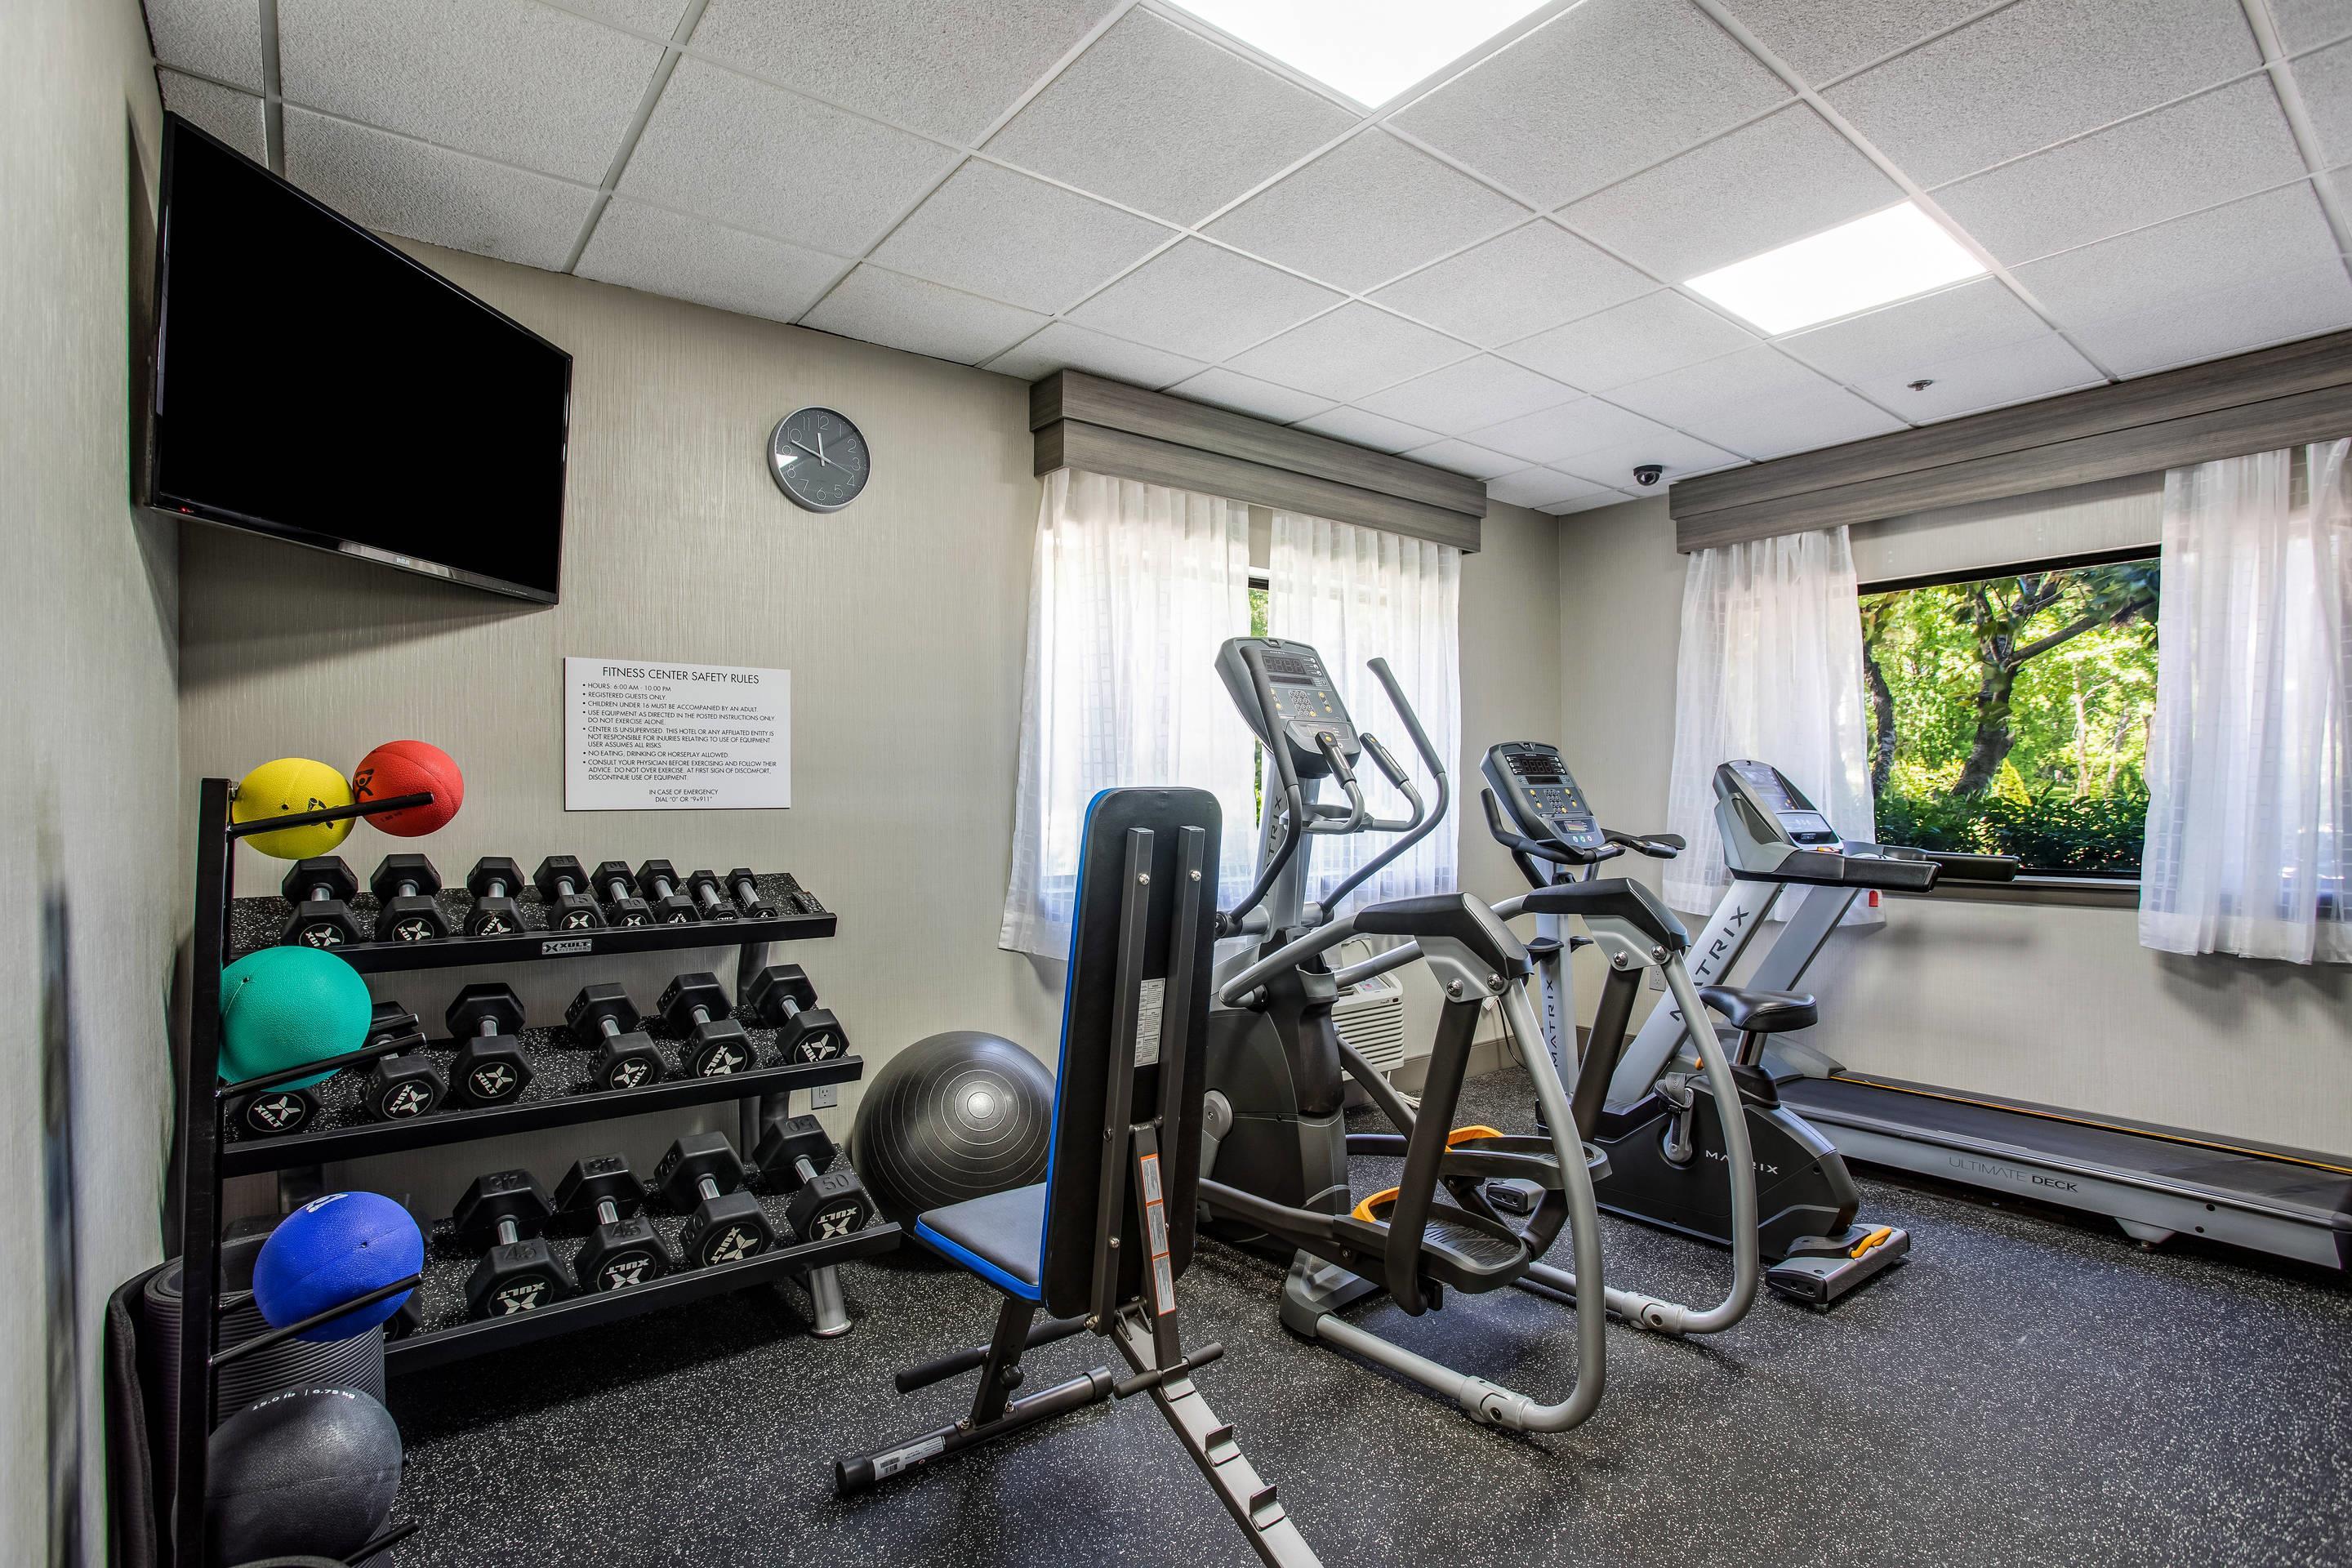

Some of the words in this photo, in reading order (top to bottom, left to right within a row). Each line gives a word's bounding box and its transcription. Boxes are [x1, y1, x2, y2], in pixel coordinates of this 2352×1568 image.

[802, 416, 810, 431] 11
[817, 414, 829, 430] 12
[787, 427, 802, 443] 10
[848, 439, 856, 453] 2
[787, 464, 796, 478] 8
[851, 457, 860, 471] 3
[800, 479, 809, 493] 7
[846, 474, 856, 487] 4
[817, 487, 826, 500] 6
[834, 485, 843, 498] 5
[603, 667, 645, 678] FITNESS
[648, 669, 688, 680] CENTER
[692, 672, 727, 682] SAFETY
[731, 674, 759, 684] RULES
[1266, 796, 1282, 869] TRIX
[1670, 906, 1749, 1021] TRIX
[1547, 980, 1558, 1067] MATRIX
[801, 1042, 819, 1062] XUL
[704, 1045, 728, 1077] XULT
[475, 1072, 497, 1094] XULT
[627, 1064, 647, 1088] XULT
[390, 1084, 413, 1113] XULT
[255, 1104, 283, 1127] XULT
[1706, 1150, 1777, 1174] MAIX
[823, 1174, 849, 1190] 50
[1949, 1156, 2026, 1182] ULTIMATE
[2032, 1175, 2078, 1192] DECK
[817, 1207, 858, 1224] XULT
[710, 1226, 741, 1264] XULT
[606, 1258, 650, 1275] XULT
[497, 1282, 545, 1300] XULT
